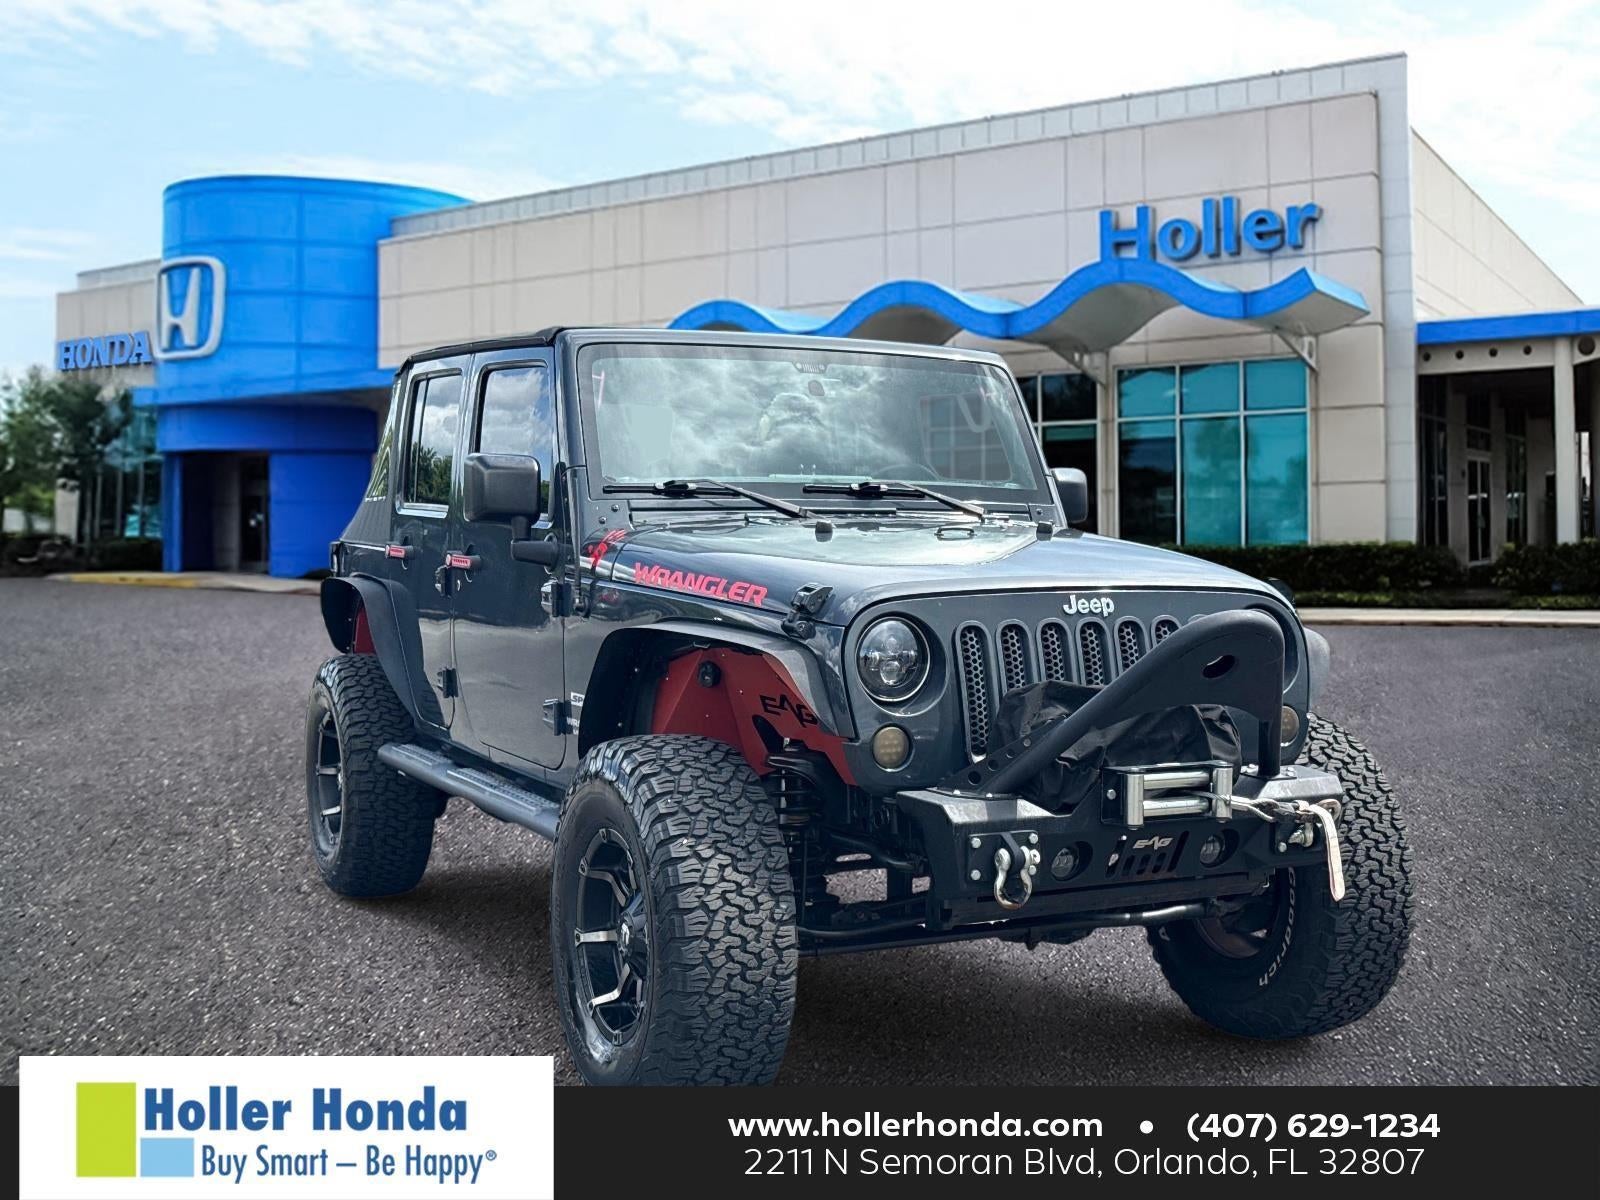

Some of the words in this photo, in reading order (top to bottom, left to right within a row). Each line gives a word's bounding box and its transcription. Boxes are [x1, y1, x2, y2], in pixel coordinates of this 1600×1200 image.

[1099, 195, 1322, 261] Holler
[58, 331, 152, 370] HONDA
[633, 562, 768, 607] WRANGLER
[1062, 594, 1115, 617] Jeep
